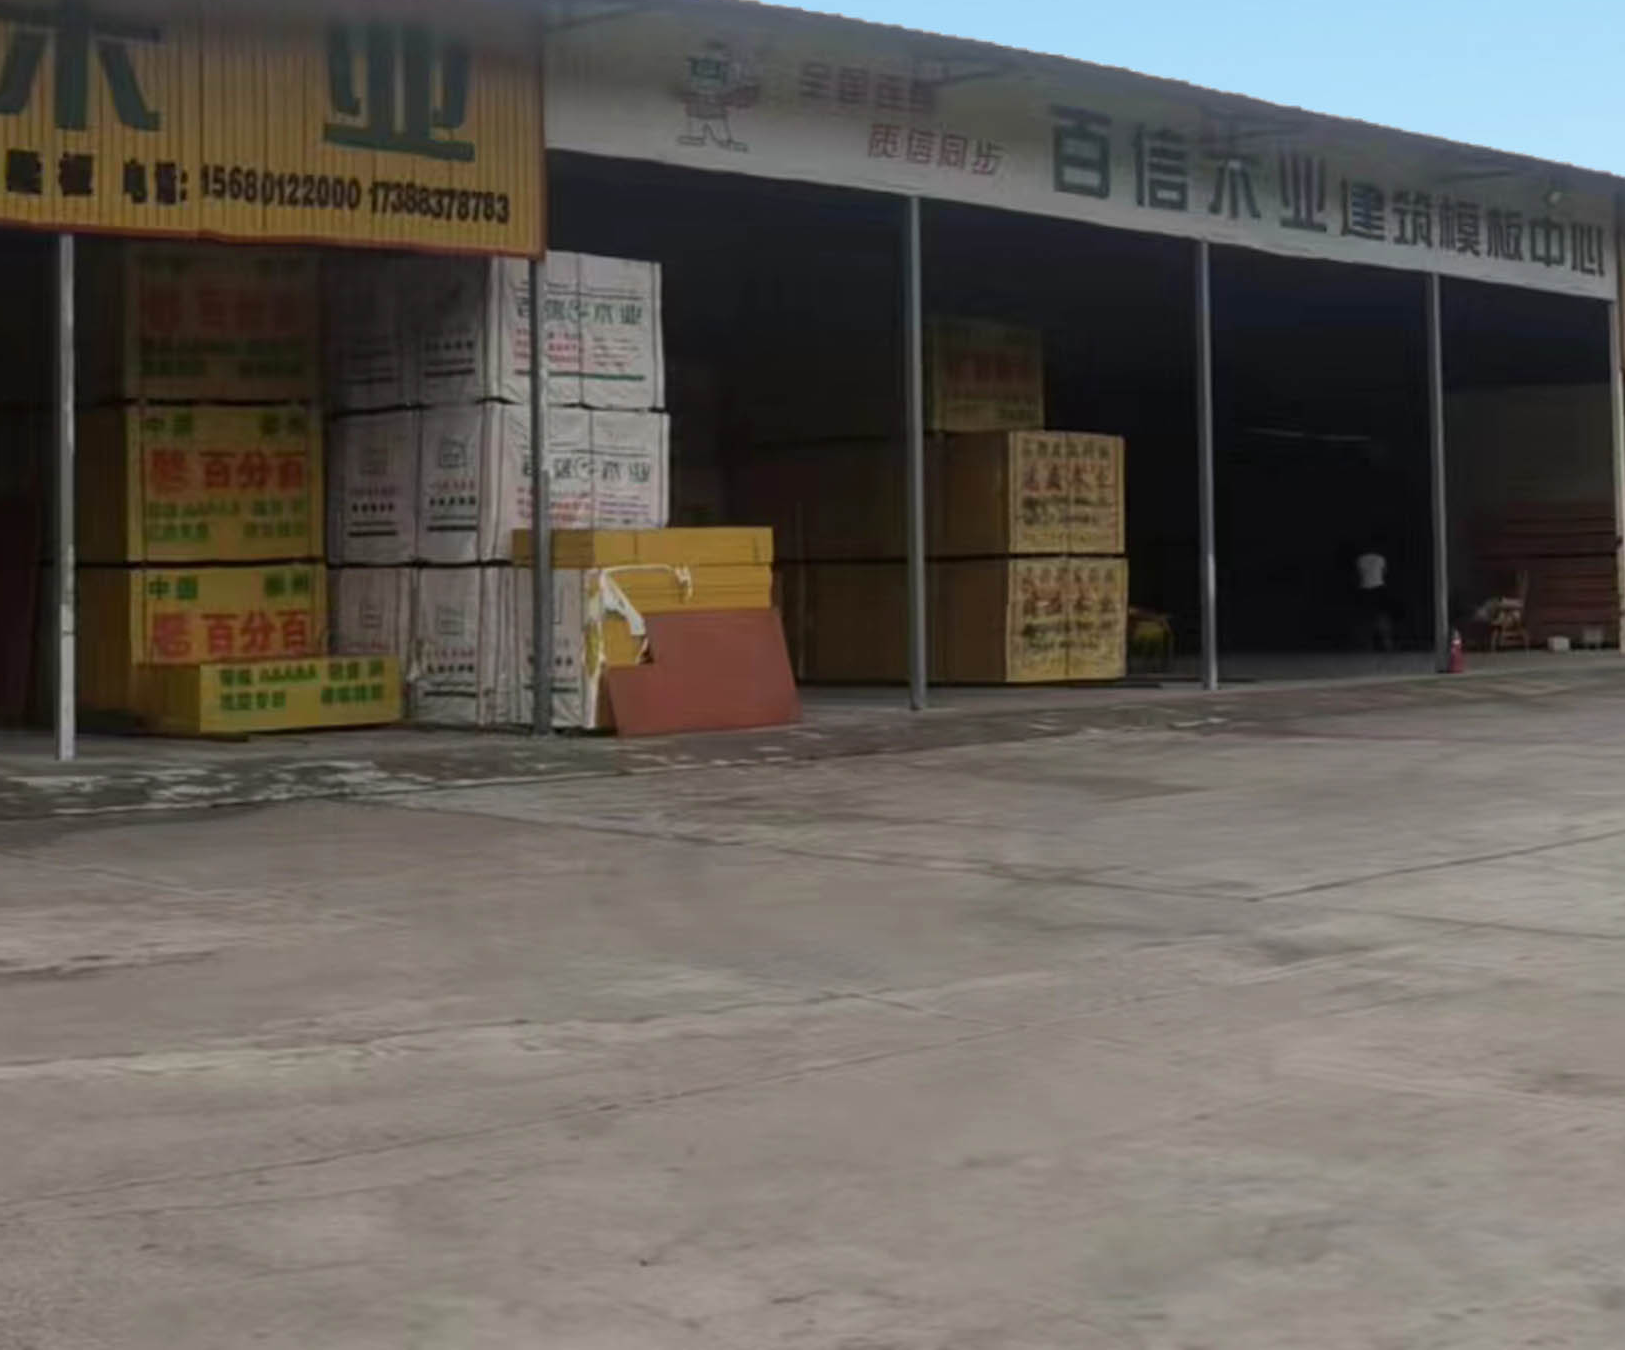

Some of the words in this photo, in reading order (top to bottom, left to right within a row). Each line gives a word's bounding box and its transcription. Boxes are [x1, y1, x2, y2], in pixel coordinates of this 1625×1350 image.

[198, 160, 362, 212] 15680122000
[370, 178, 513, 226] 17388378783
[1048, 103, 1608, 278] 百信木业建筑模板中心
[198, 449, 307, 491] 百分百
[199, 610, 310, 651] 百分百
